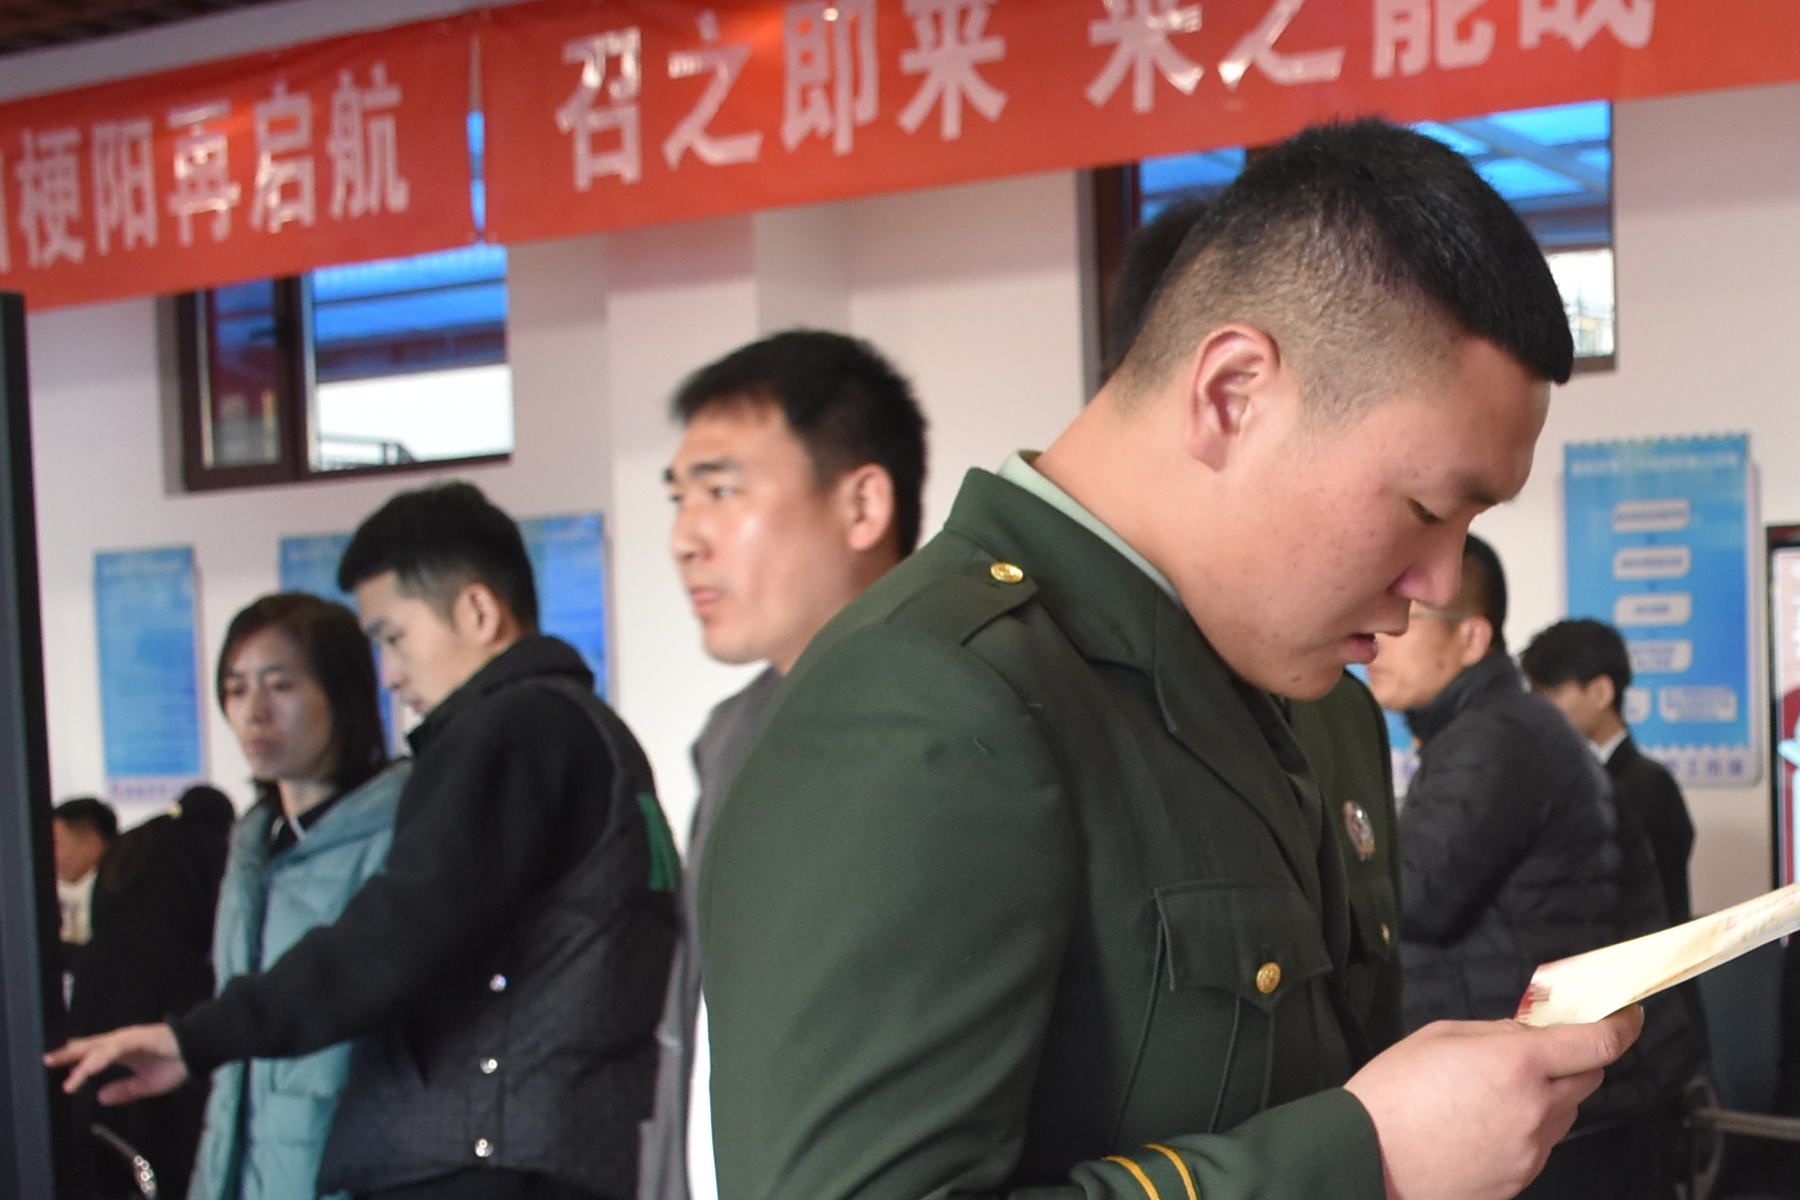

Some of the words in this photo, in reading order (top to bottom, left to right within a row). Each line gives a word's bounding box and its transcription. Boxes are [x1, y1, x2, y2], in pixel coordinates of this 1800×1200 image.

[0, 64, 411, 273] 梗阳再启航
[556, 0, 1008, 193] 召之即来
